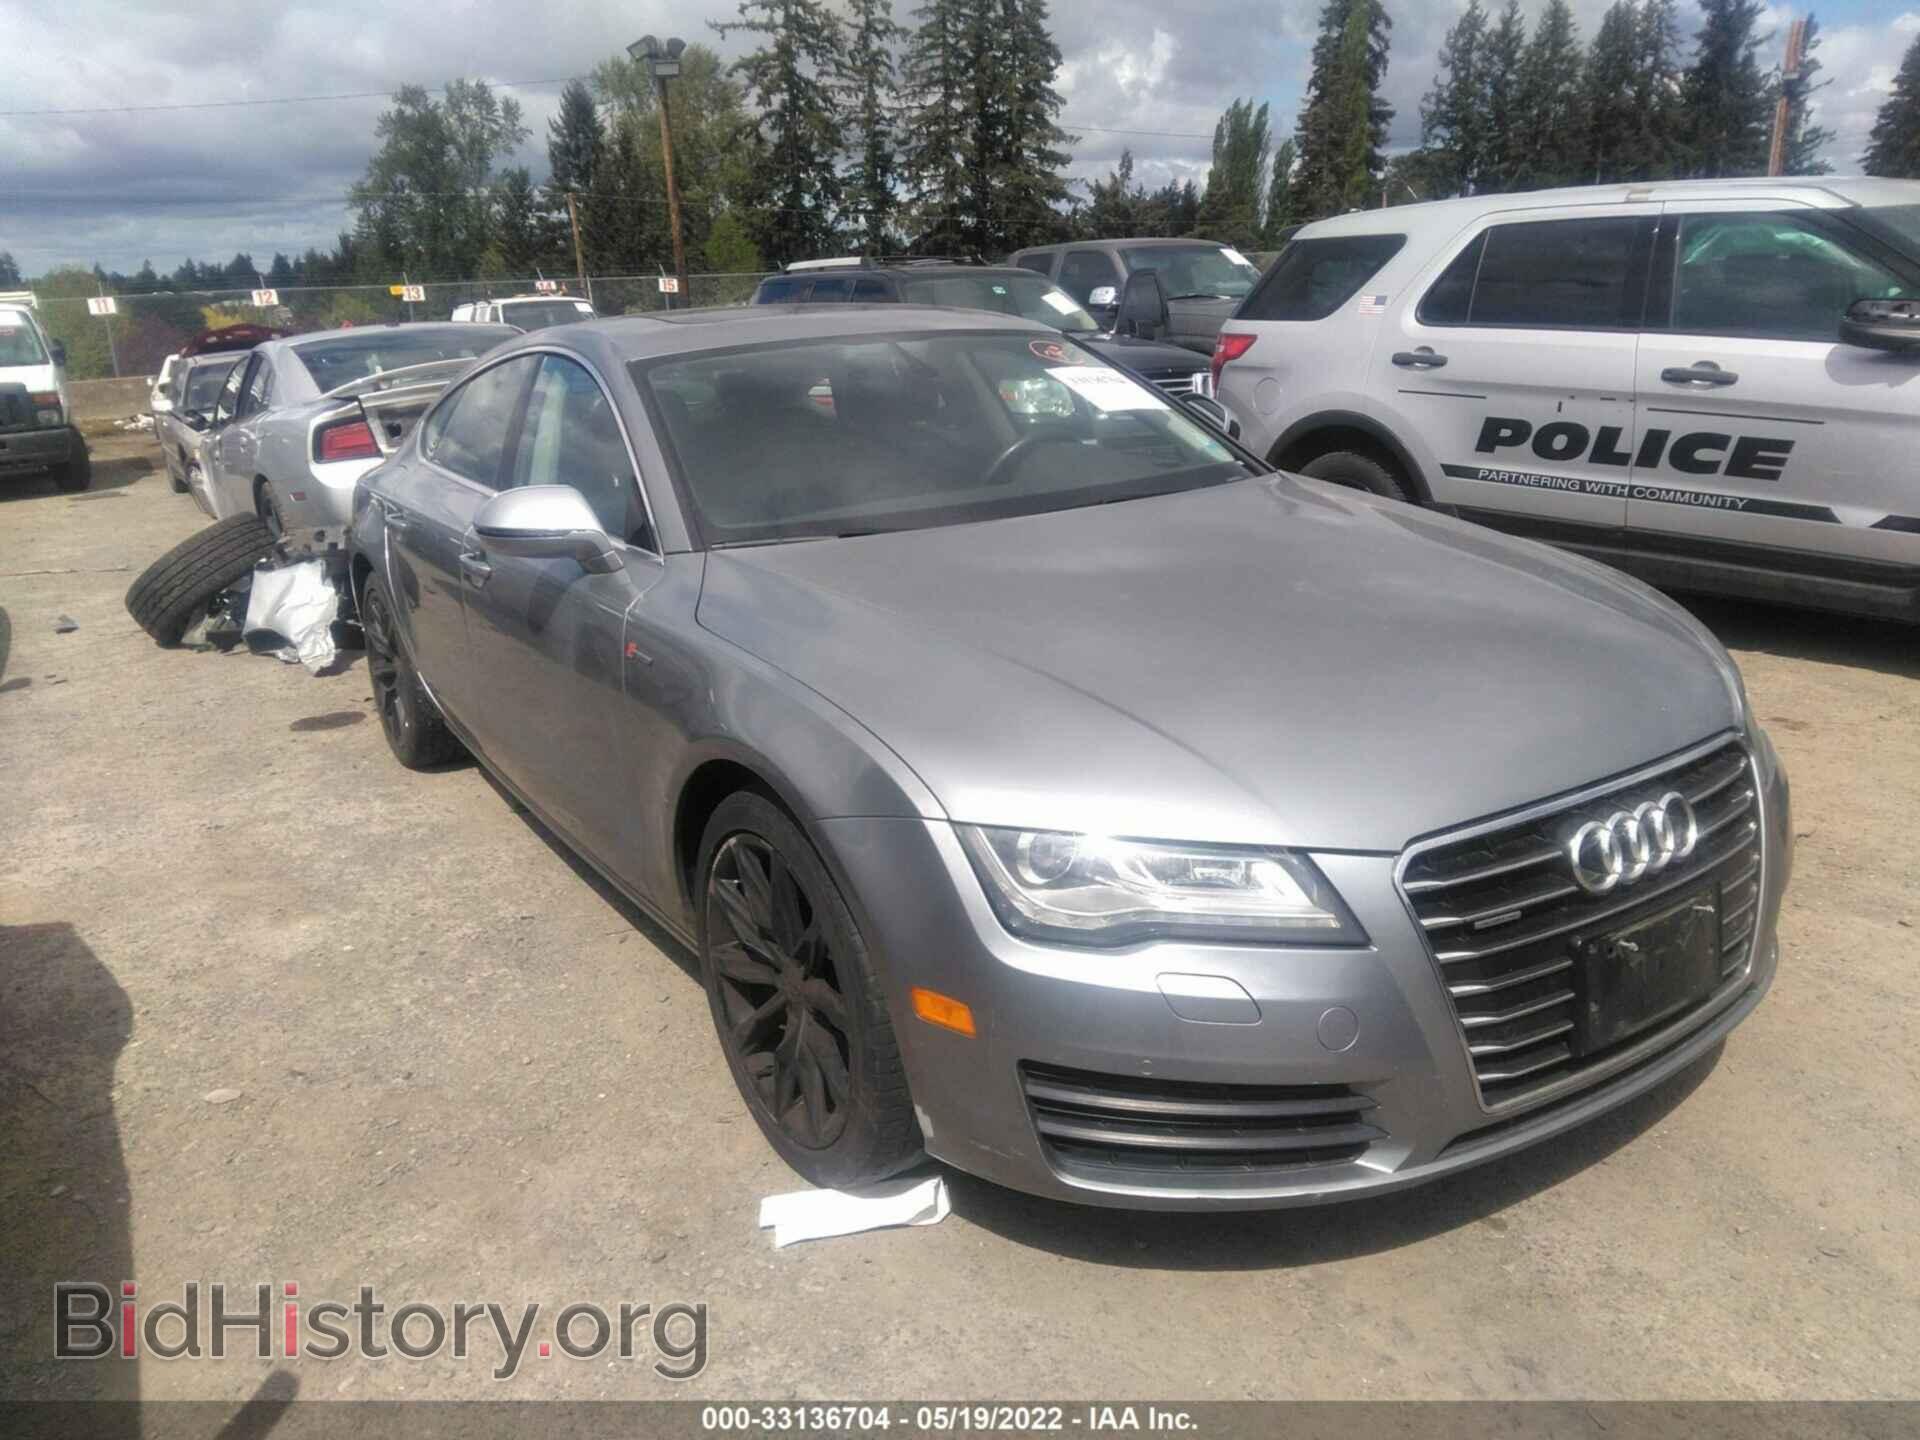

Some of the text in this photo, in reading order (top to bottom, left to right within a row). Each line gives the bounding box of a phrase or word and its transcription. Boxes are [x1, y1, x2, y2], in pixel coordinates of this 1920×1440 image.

[662, 279, 675, 292] 15
[256, 290, 273, 305] 12
[405, 287, 421, 300] 13
[95, 298, 109, 313] 11
[1474, 416, 1795, 481] POLICE
[1478, 469, 1750, 509] PARTNERING WITH COMMUNITY
